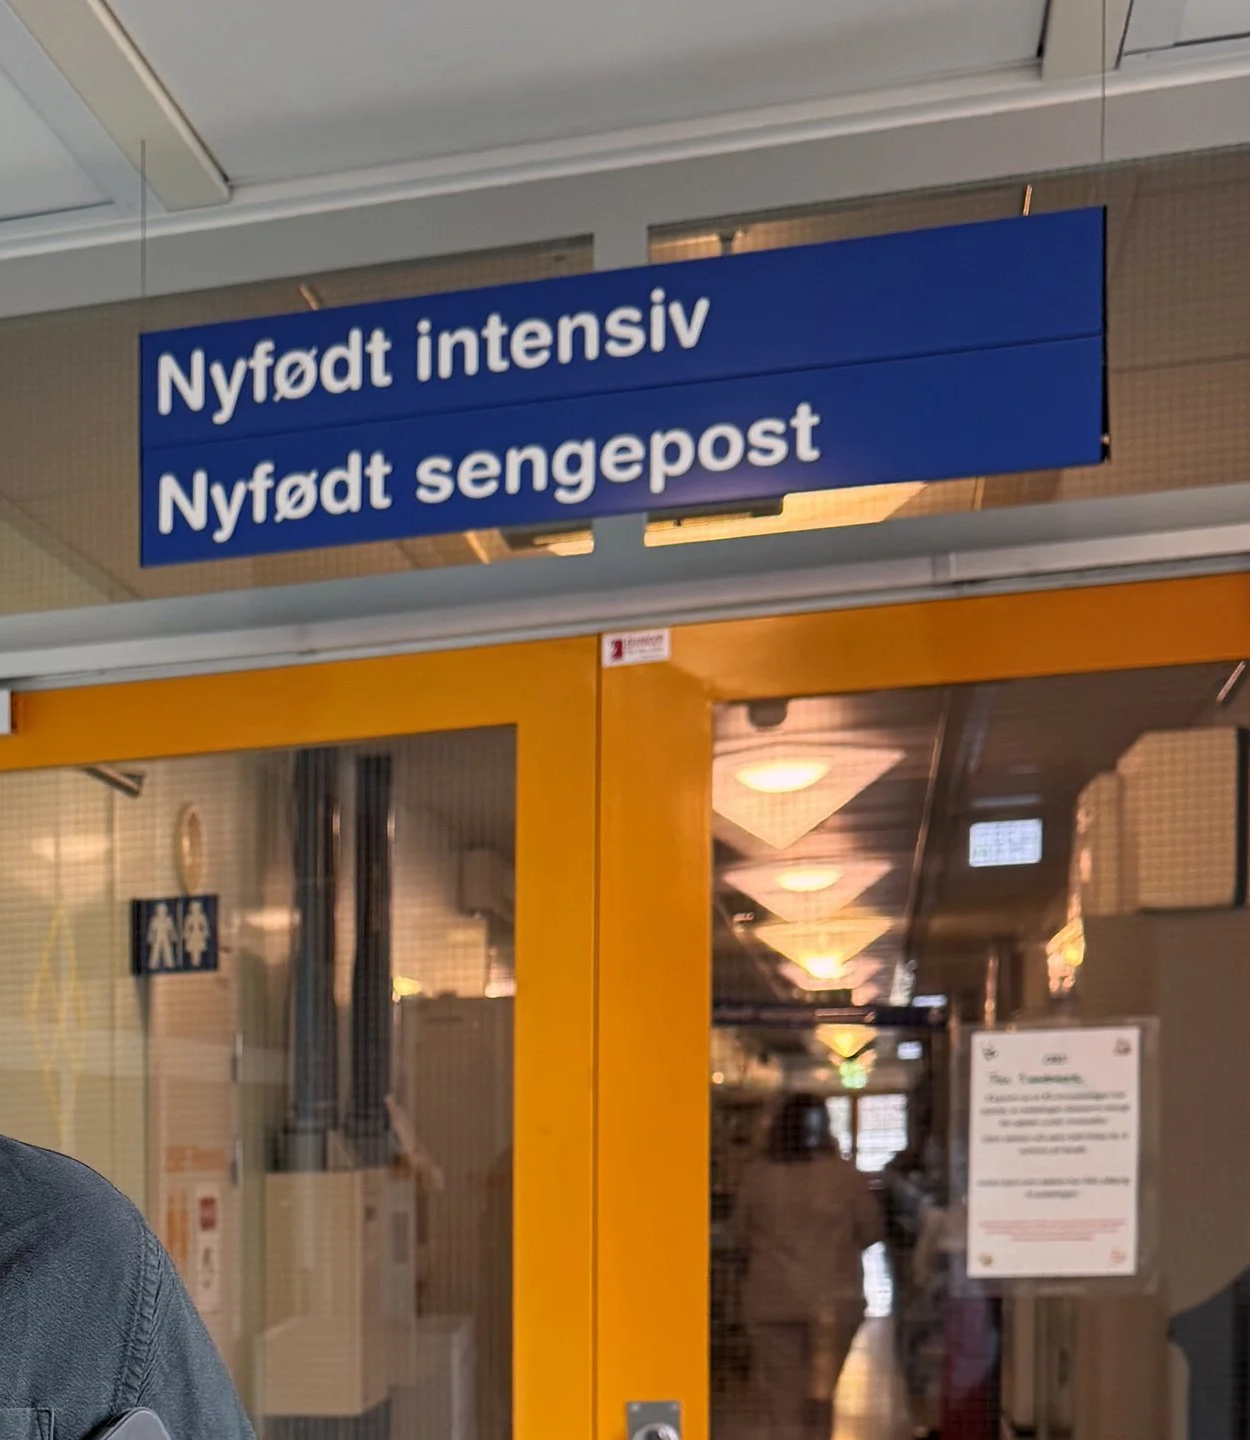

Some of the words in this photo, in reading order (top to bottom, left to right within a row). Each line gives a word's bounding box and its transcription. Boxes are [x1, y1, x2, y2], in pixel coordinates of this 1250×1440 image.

[157, 327, 394, 425] Nyfødt
[416, 287, 711, 382] intensiv
[158, 448, 393, 544] Nyfødt
[415, 401, 821, 505] sengepost
